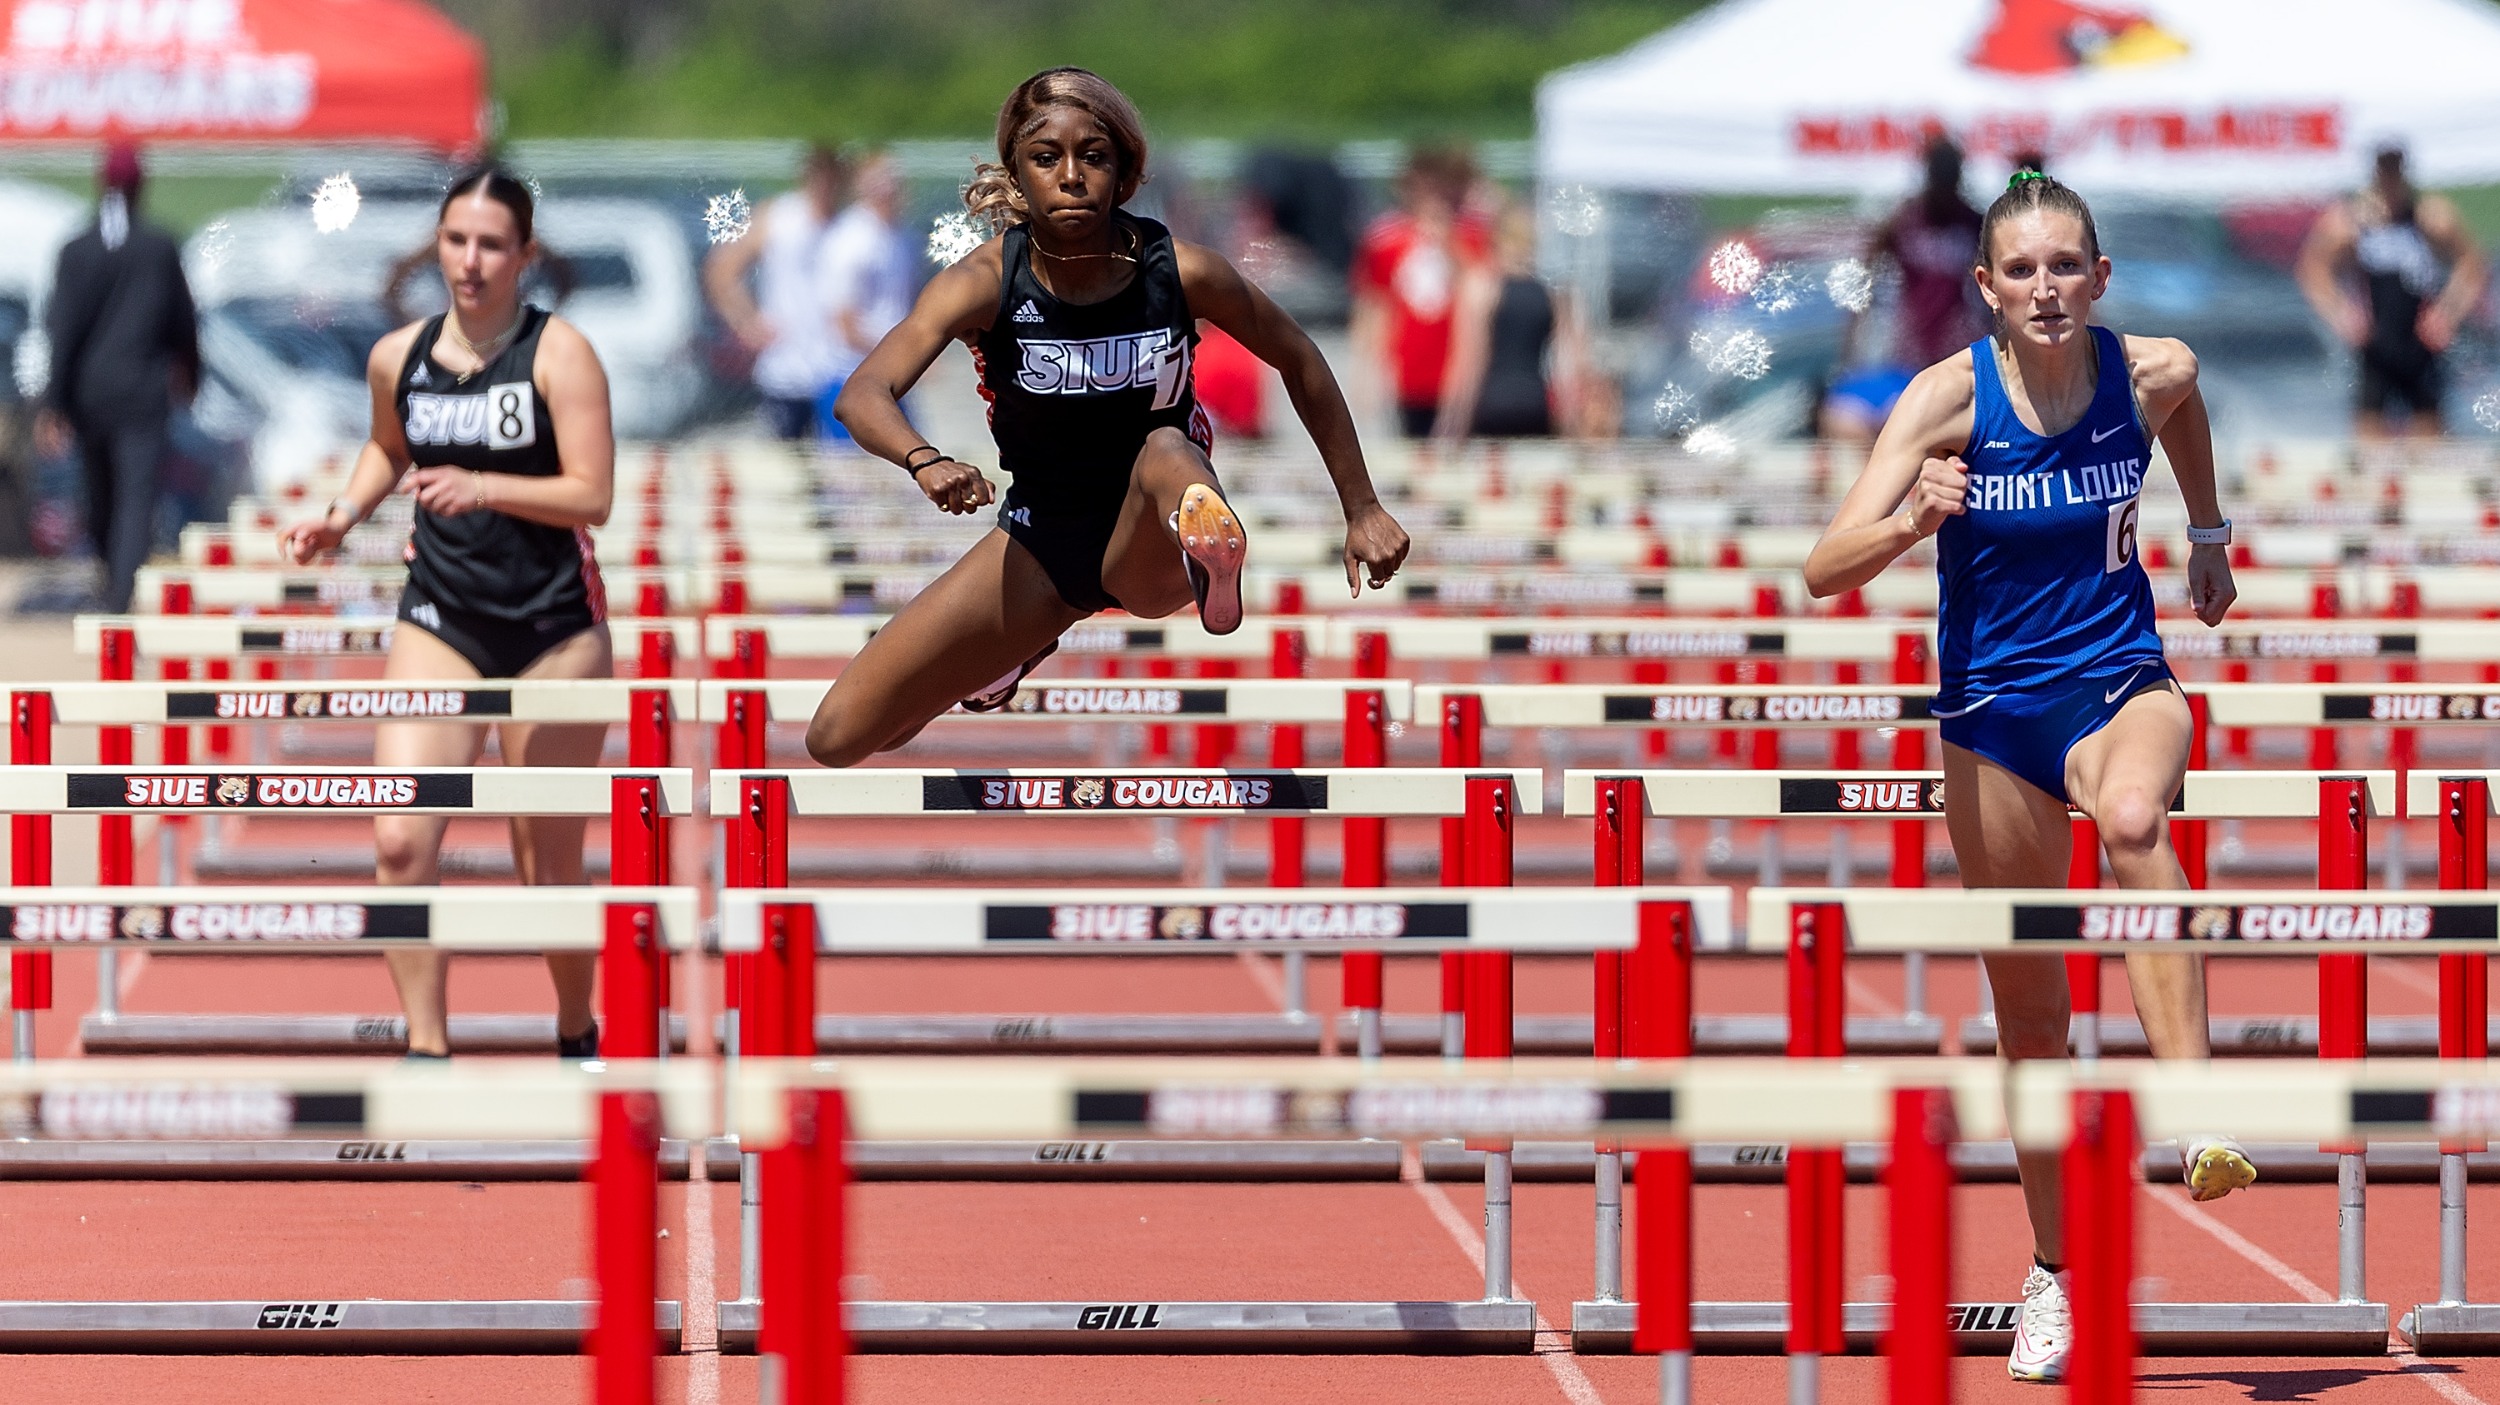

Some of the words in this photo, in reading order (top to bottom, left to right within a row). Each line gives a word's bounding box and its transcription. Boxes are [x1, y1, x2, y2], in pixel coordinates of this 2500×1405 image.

[1012, 313, 1045, 323] adidas
[1163, 345, 1185, 407] 7
[405, 390, 490, 446] SIU
[500, 392, 522, 439] 8
[1966, 471, 2054, 511] SAINT
[2063, 457, 2142, 505] LOUIS
[2116, 499, 2137, 565] 6
[216, 691, 286, 718] SIUE
[327, 690, 467, 717] COUGARS
[1043, 688, 1183, 714] COUGARS
[1650, 695, 1723, 721] SIUE
[1762, 695, 1902, 721] COUGARS
[2369, 694, 2443, 720] SIUE
[124, 776, 209, 806] SIUE
[255, 776, 417, 806] COUGARS
[980, 778, 1065, 808] SIUE
[1111, 777, 1274, 808] COUGARS
[1837, 780, 1923, 812] SIUE
[11, 903, 115, 942] SIUE
[168, 903, 369, 942] COUGARS
[1049, 903, 1154, 941] SIUE
[1206, 903, 1408, 941] COUGARS
[2080, 904, 2184, 941] SIUE
[2237, 904, 2434, 941] COUGARS
[336, 1142, 407, 1161] GILL
[1038, 1142, 1108, 1162] GILL
[257, 1303, 340, 1329] GILL
[1077, 1304, 1160, 1330] GILL
